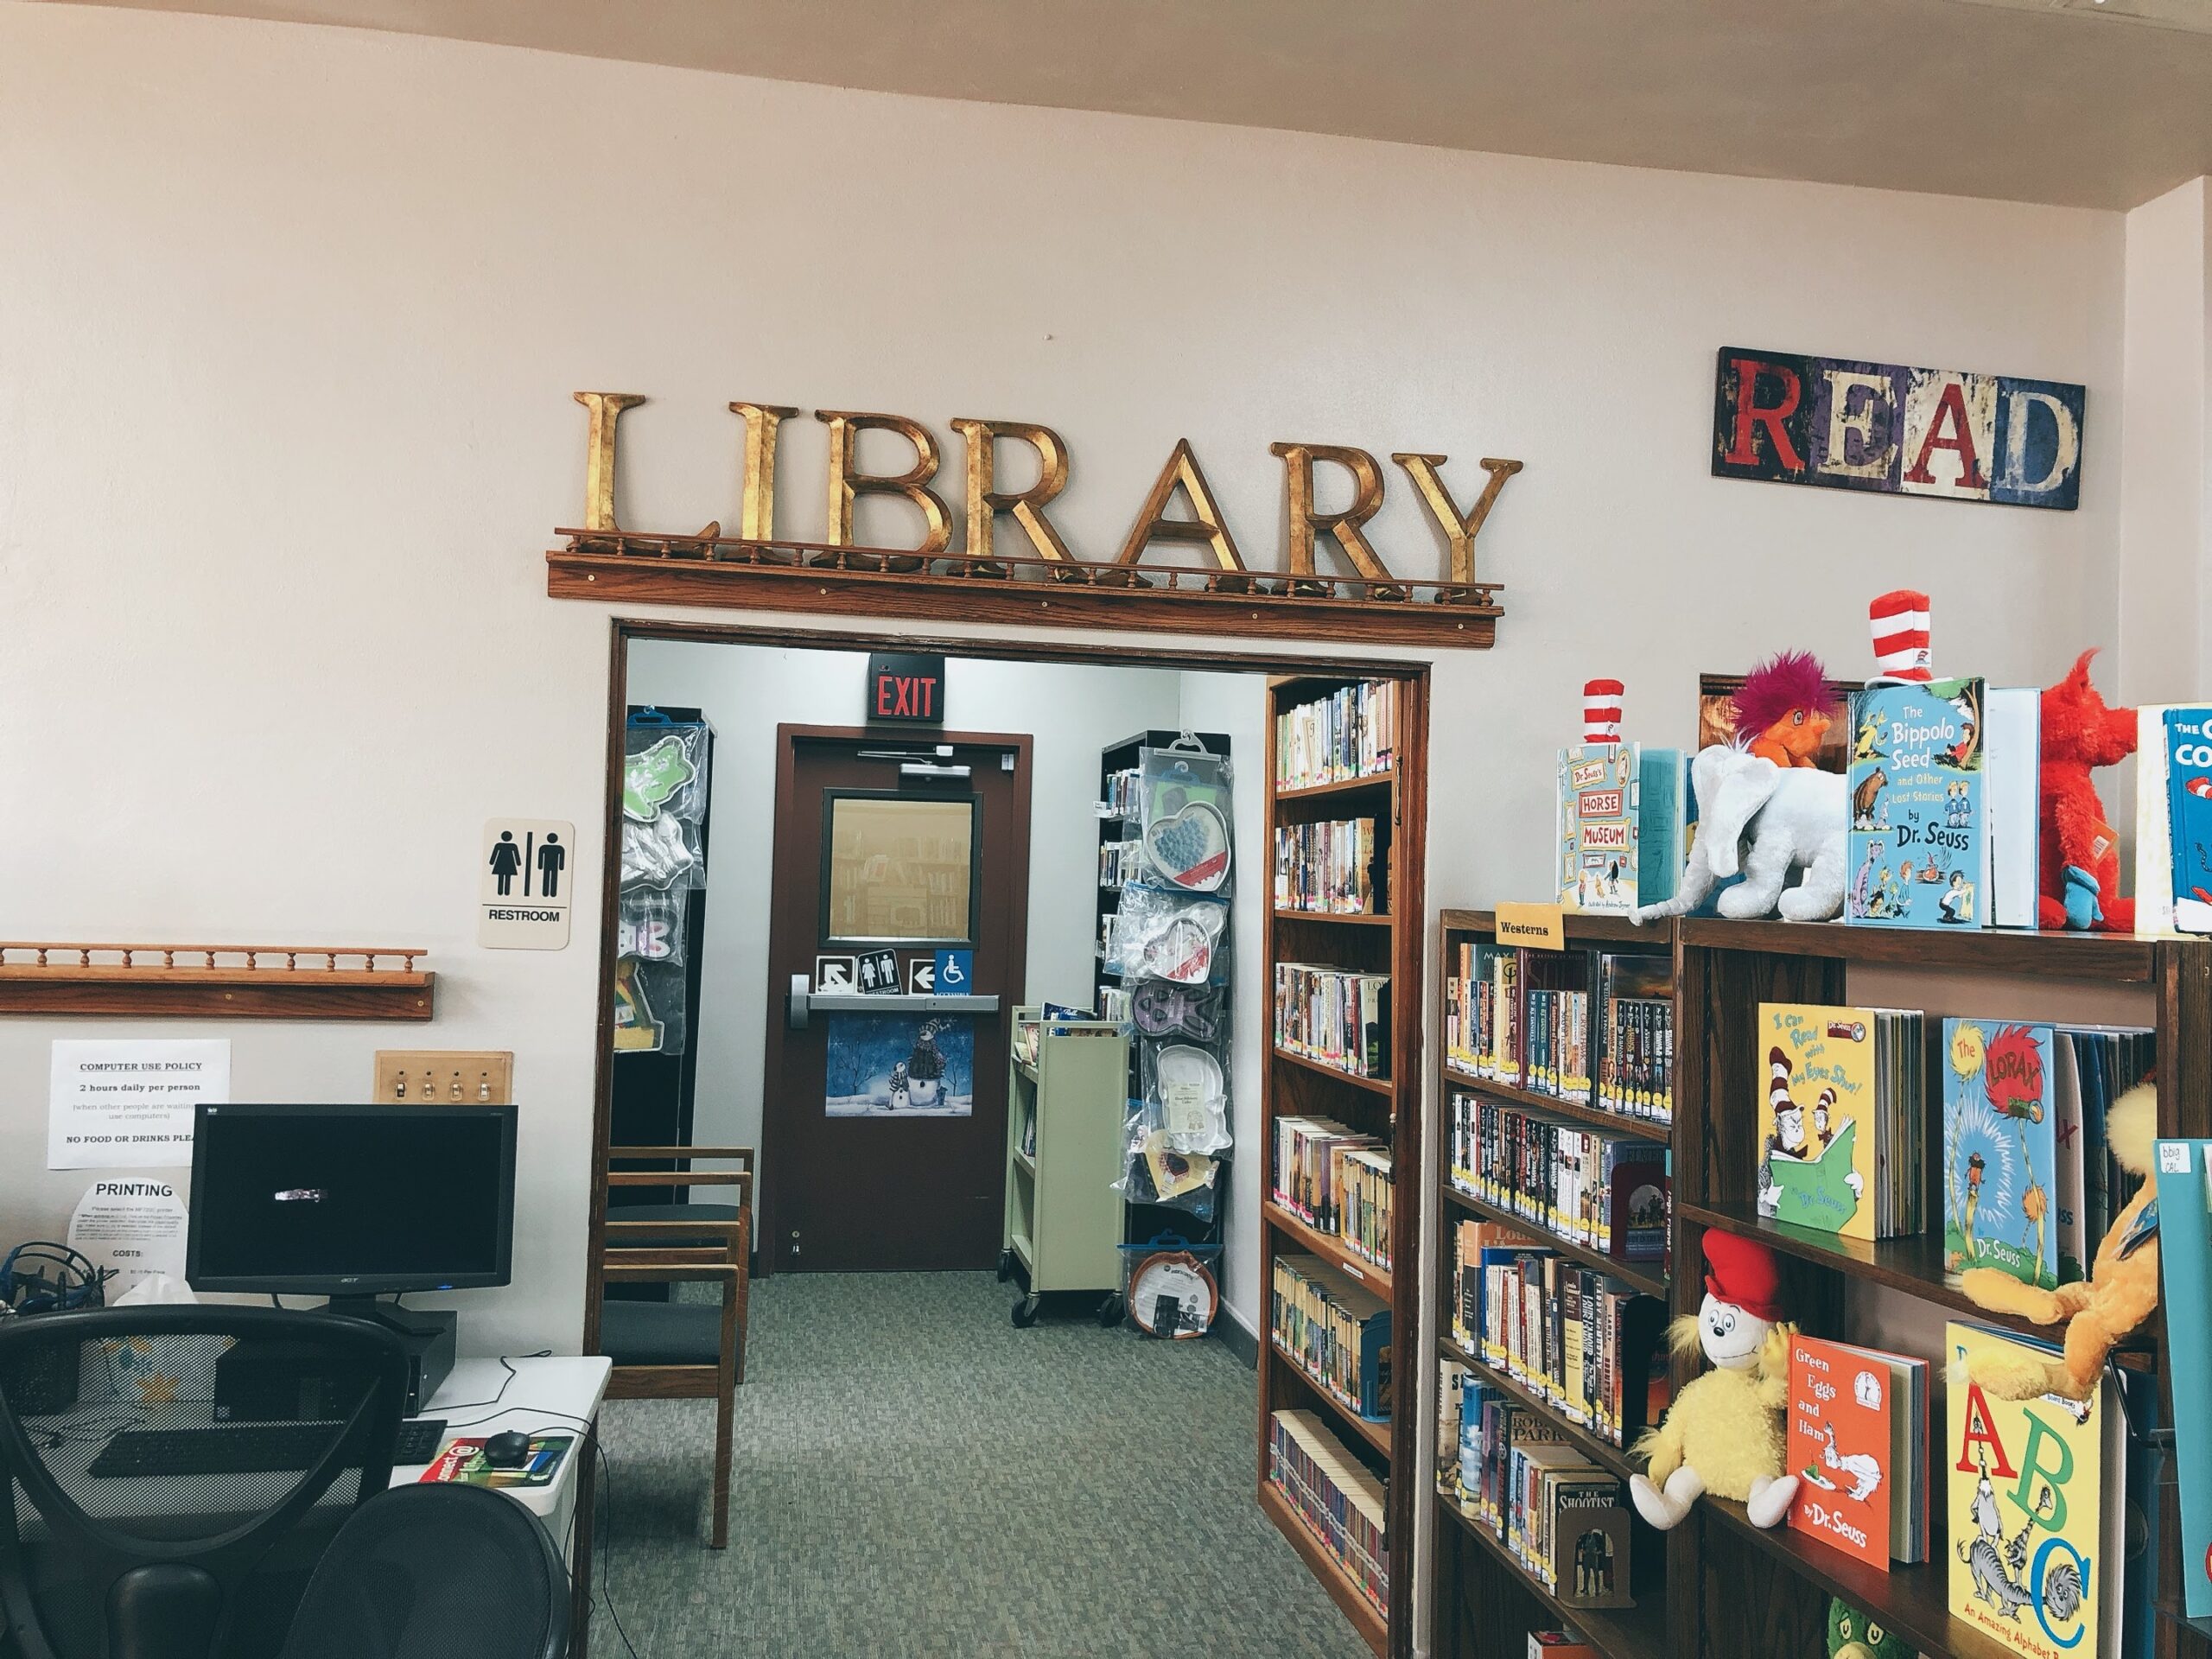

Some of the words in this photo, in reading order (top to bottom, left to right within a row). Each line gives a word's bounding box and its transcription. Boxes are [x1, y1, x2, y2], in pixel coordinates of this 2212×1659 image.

[1725, 359, 2079, 492] READ
[566, 391, 1523, 605] LIBRARY
[878, 677, 937, 717] EXIT
[1903, 705, 1923, 719] The
[1891, 716, 1955, 750] Bippolo
[2174, 723, 2200, 734] THE
[1891, 747, 1930, 770] Seed
[1897, 776, 1913, 785] and
[1916, 772, 1943, 785] Other
[1583, 796, 1618, 811] HORSE
[1892, 792, 1910, 804] Lost
[1913, 791, 1944, 802] Stories
[1908, 809, 1919, 823] by
[1584, 827, 1624, 845] MUSEUM
[1897, 824, 1921, 848] Dr.
[1924, 822, 1969, 851] Seuss
[488, 909, 560, 922] RESTROOM
[1500, 921, 1549, 937] Westerns
[1773, 1013, 1782, 1030] I
[1784, 1014, 1804, 1027] Can
[1790, 1026, 1818, 1050] Read
[1804, 1043, 1825, 1059] with
[1957, 1039, 1975, 1058] The
[80, 1063, 138, 1071] COMPUTER
[142, 1063, 162, 1071] USE
[165, 1062, 202, 1071] POLICY
[1791, 1072, 1806, 1087] My
[1805, 1062, 1829, 1082] Eyes
[1988, 1051, 2040, 1091] LORAX
[121, 1084, 145, 1092] daily
[124, 1103, 149, 1111] people
[125, 1112, 170, 1121] computers)
[96, 1183, 173, 1197] PRINTING
[112, 1249, 143, 1258] COSTS:
[1977, 1238, 1992, 1257] Dr.
[1993, 1239, 2020, 1268] Seuss
[1796, 1348, 1829, 1372] Green
[1807, 1373, 1837, 1402] Eggs
[1798, 1400, 1820, 1417] and
[1799, 1419, 1825, 1442] Ham
[1956, 1382, 2018, 1479] A
[2006, 1407, 2075, 1533] B
[1560, 1496, 1614, 1509] SHOOTIST
[1812, 1503, 1832, 1529] Dr.
[1832, 1510, 1866, 1548] Seuss
[2031, 1538, 2091, 1649] C
[1964, 1603, 1975, 1618] An
[1978, 1612, 2012, 1642] Amazing
[2014, 1631, 2050, 1659] Alphabet
